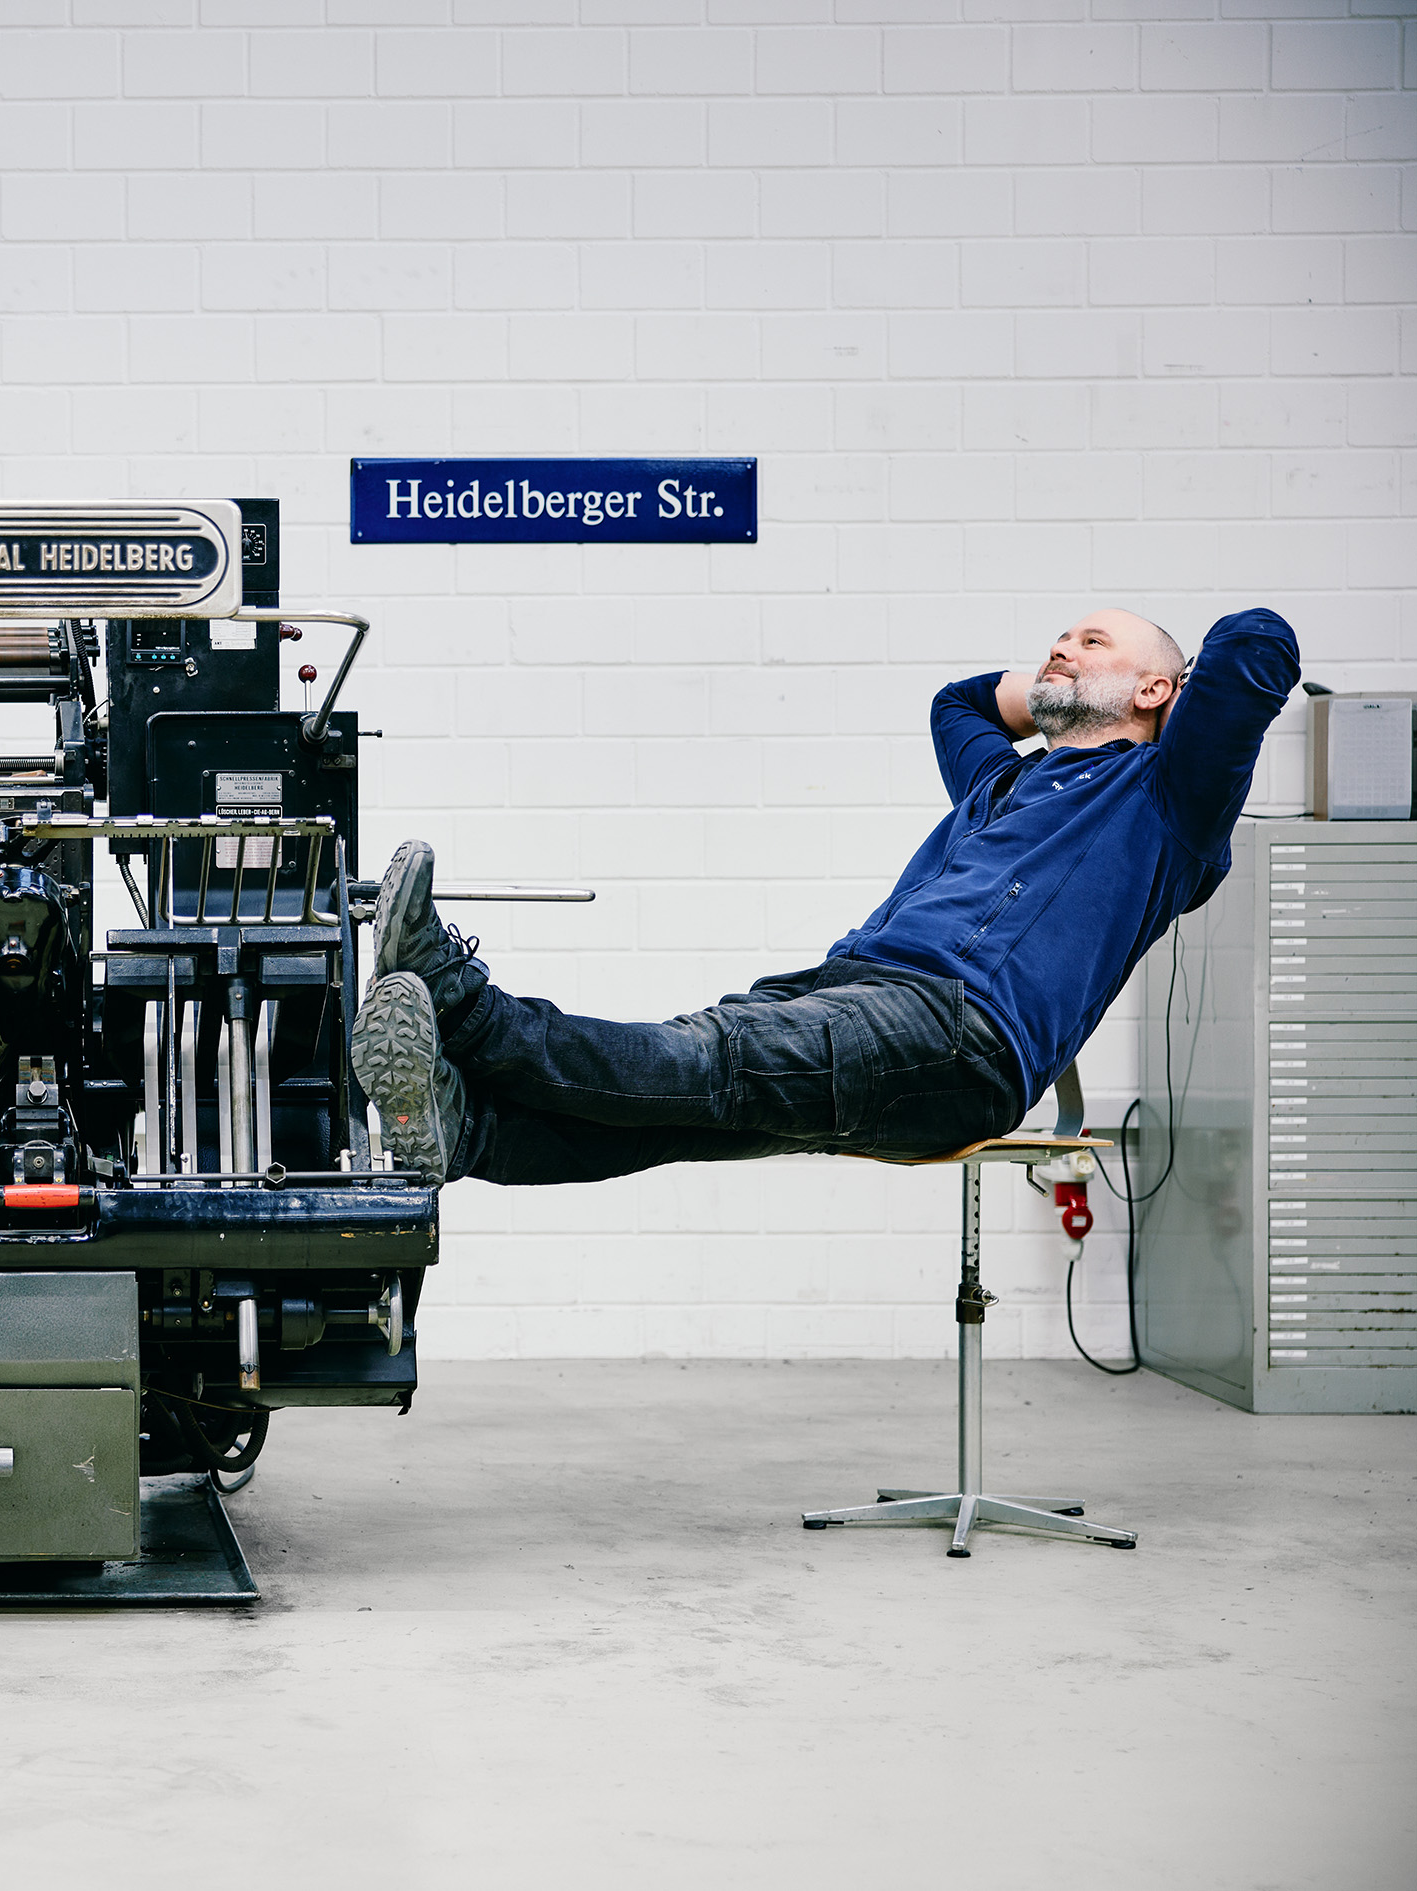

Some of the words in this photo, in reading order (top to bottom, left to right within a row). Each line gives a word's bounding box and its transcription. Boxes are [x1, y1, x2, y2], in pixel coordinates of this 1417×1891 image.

[386, 479, 641, 525] Heidelberger
[657, 479, 724, 519] Str.
[41, 543, 194, 572] HEIDELBERG
